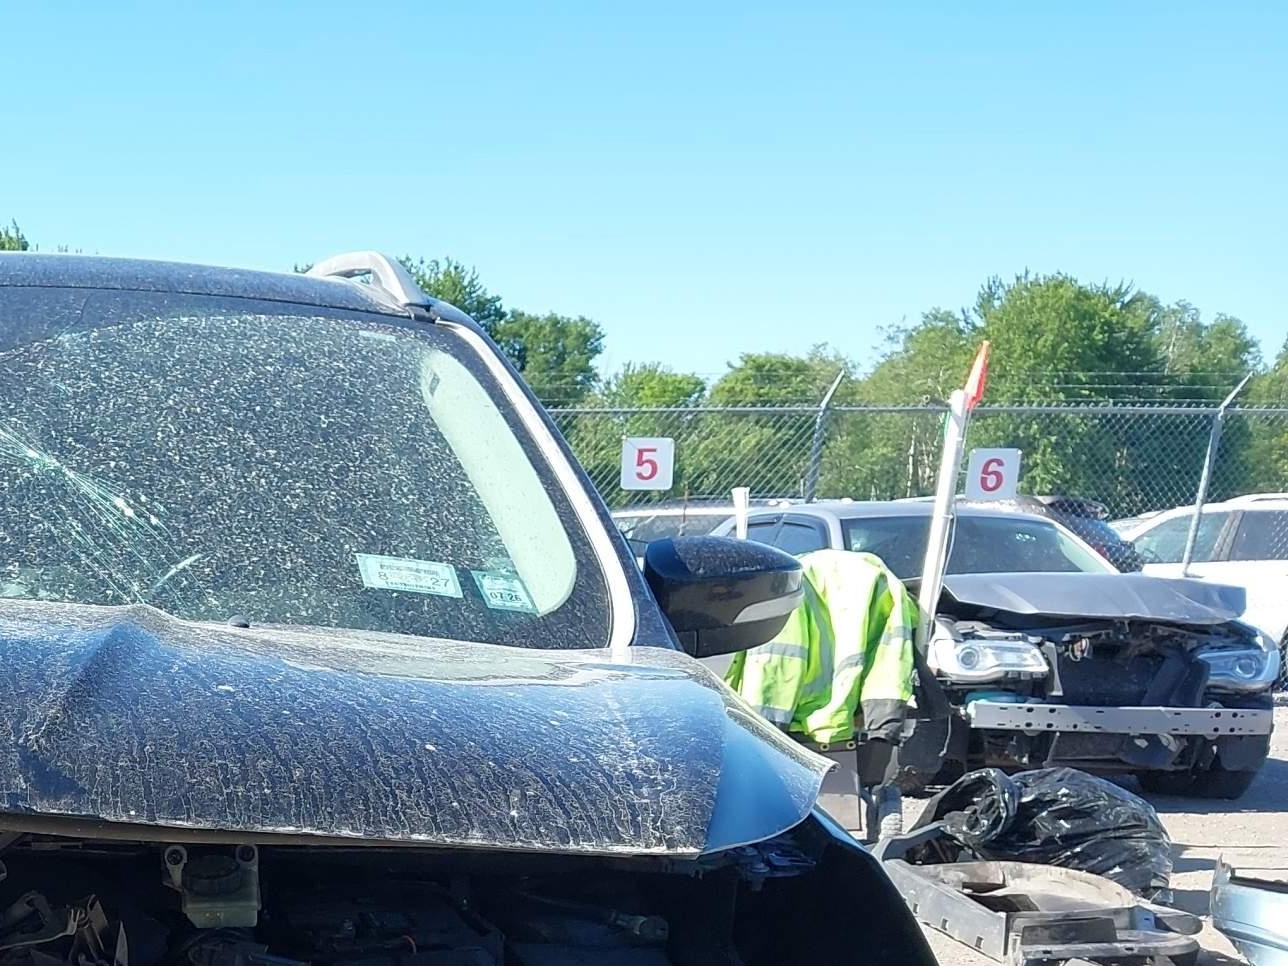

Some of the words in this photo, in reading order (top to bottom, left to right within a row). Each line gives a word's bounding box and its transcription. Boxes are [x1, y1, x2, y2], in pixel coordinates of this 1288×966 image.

[635, 447, 658, 481] 5
[980, 458, 1005, 492] 6
[378, 571, 389, 581] 8
[430, 577, 450, 588] 27
